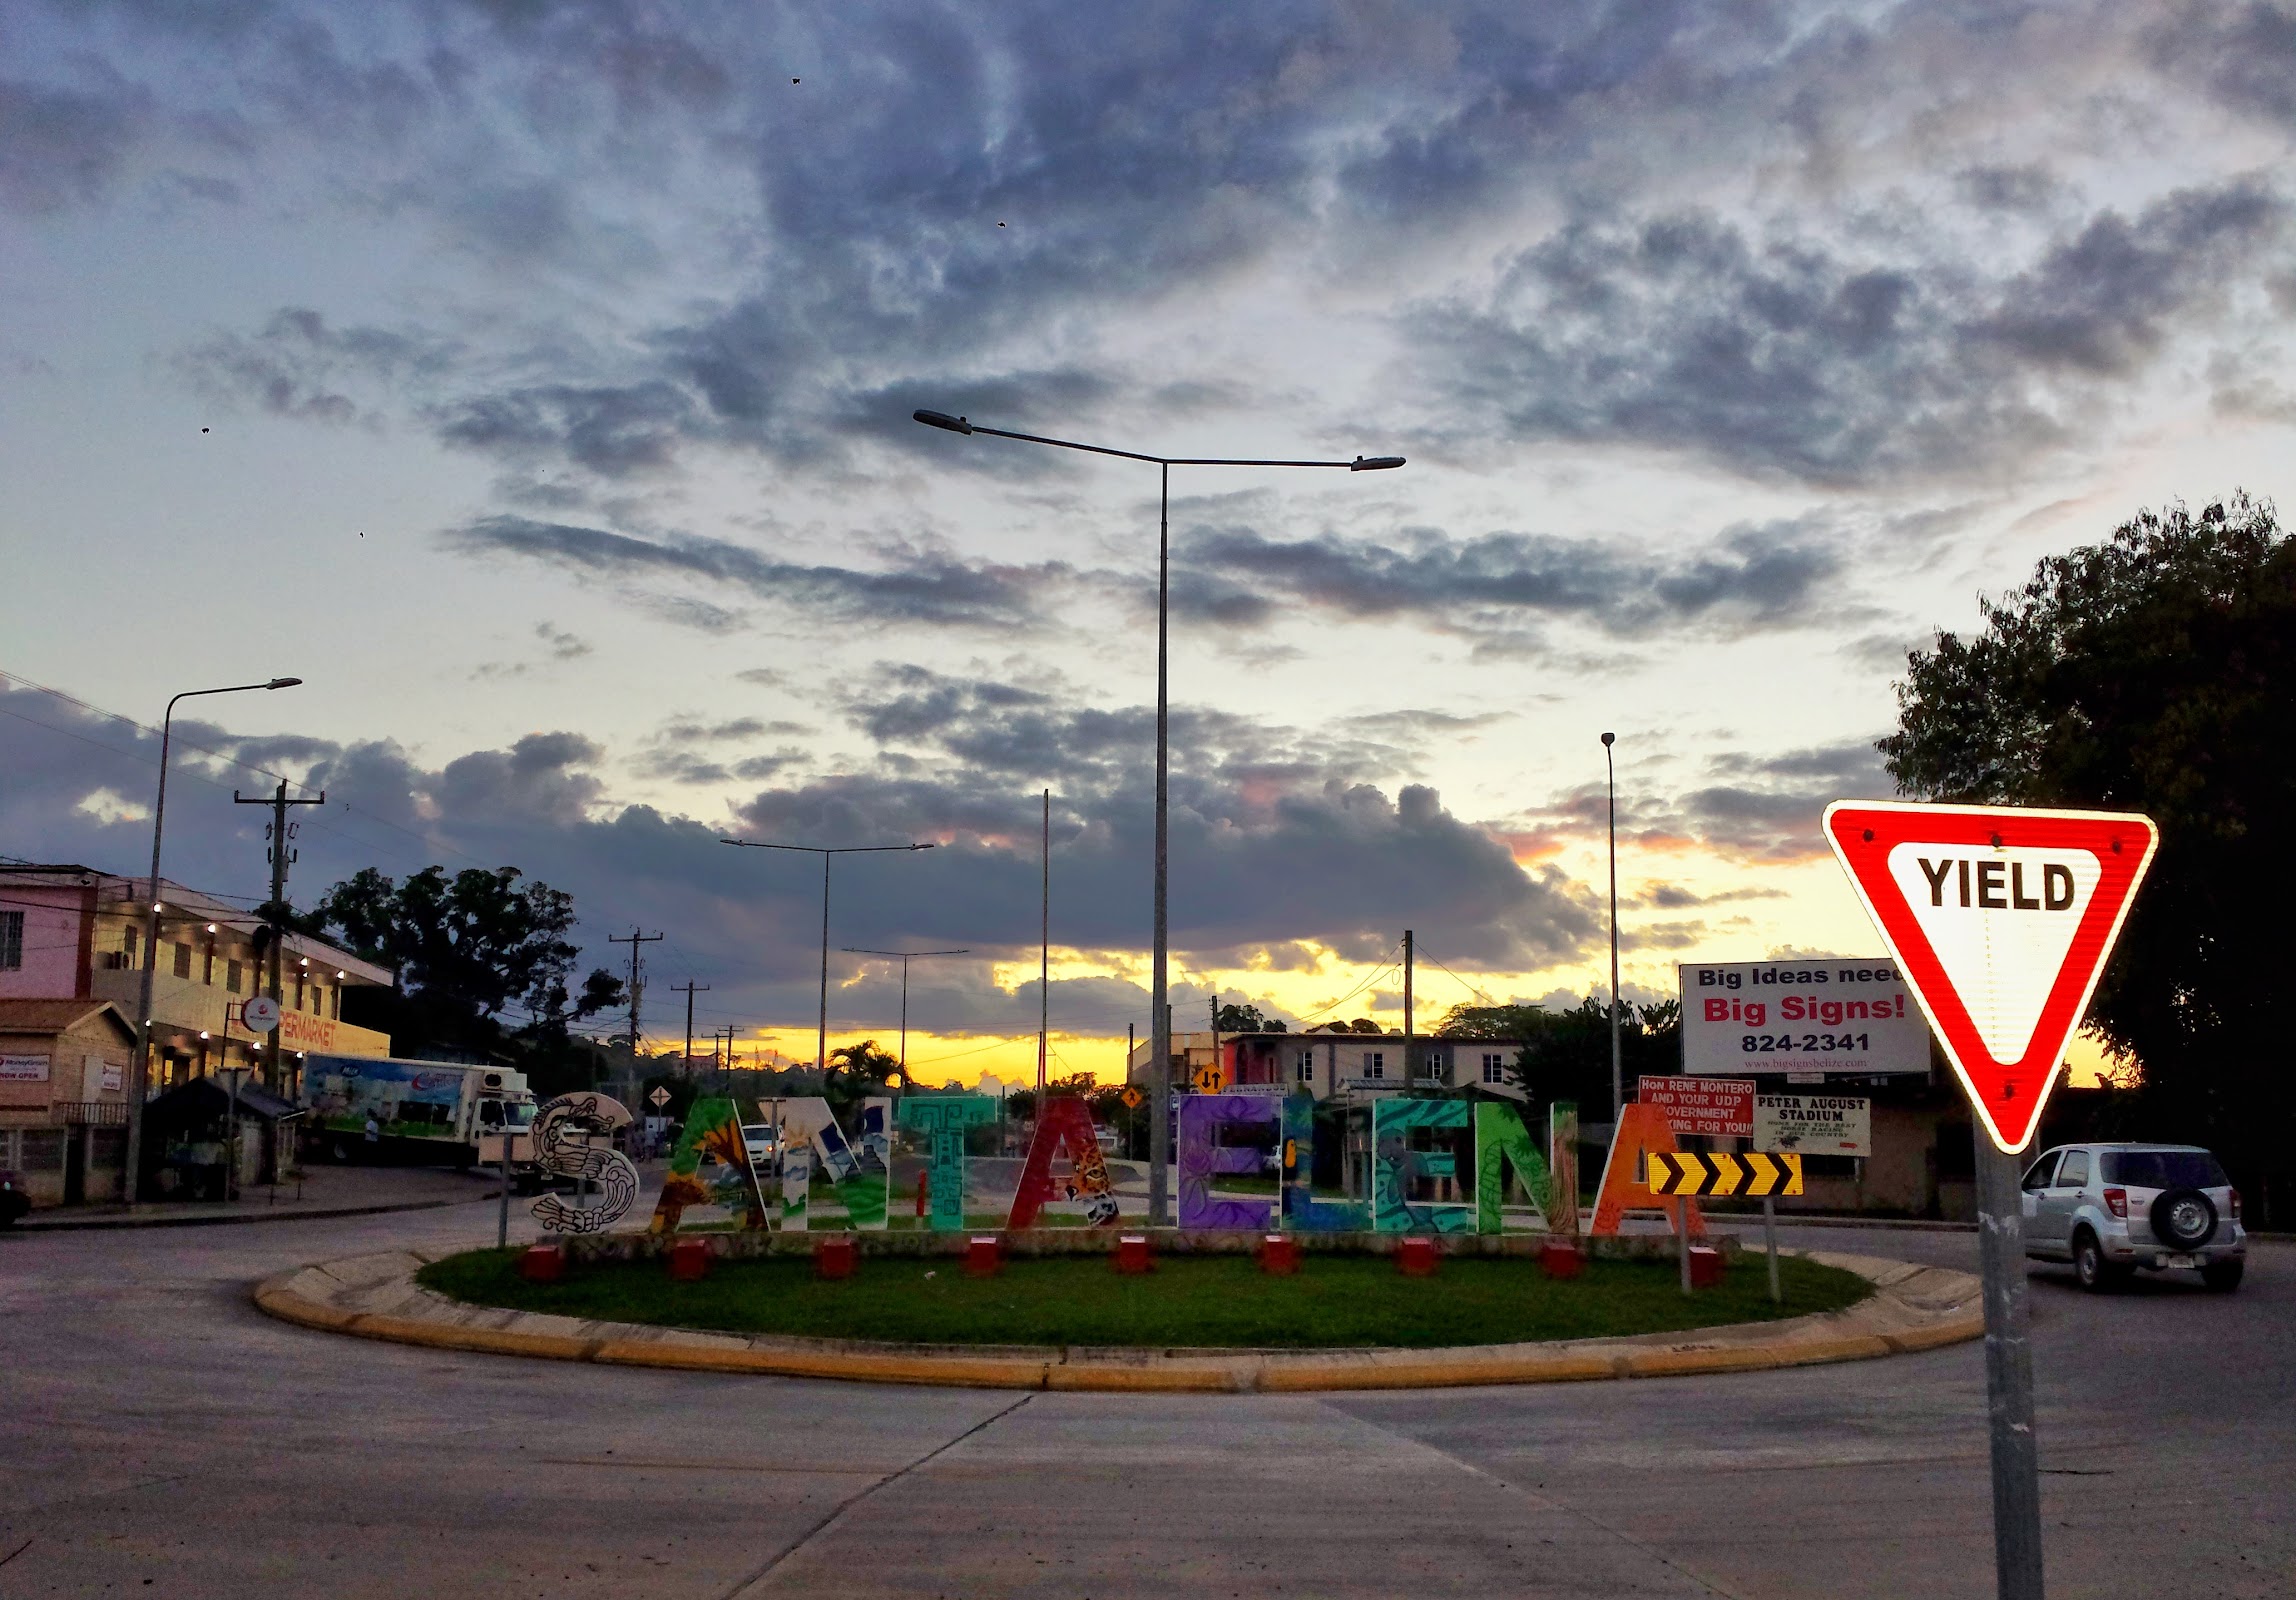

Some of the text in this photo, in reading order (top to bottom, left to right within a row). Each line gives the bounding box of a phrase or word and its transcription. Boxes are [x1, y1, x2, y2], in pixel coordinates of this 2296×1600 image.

[1917, 858, 2075, 911] YIELD
[1699, 969, 1742, 989] Big
[1752, 967, 1829, 984] Ideas
[1704, 994, 1905, 1027] Big Signs!
[1742, 1033, 1869, 1052] 824-2341
[1744, 1058, 1867, 1070] www.bigsignsbelize.com
[1669, 1080, 1696, 1092] RENE
[1700, 1082, 1752, 1094] MONTERO
[1651, 1093, 1674, 1104] AND
[1680, 1094, 1709, 1105] YOUR
[1758, 1097, 1865, 1109] PETER AUGUST
[1664, 1106, 1735, 1119] OVERNMENT
[1780, 1110, 1843, 1121] STADIUM
[1697, 1121, 1720, 1132] FOR
[1724, 1122, 1753, 1133] YOU!!
[531, 1092, 1707, 1235] SANTA ELENA
